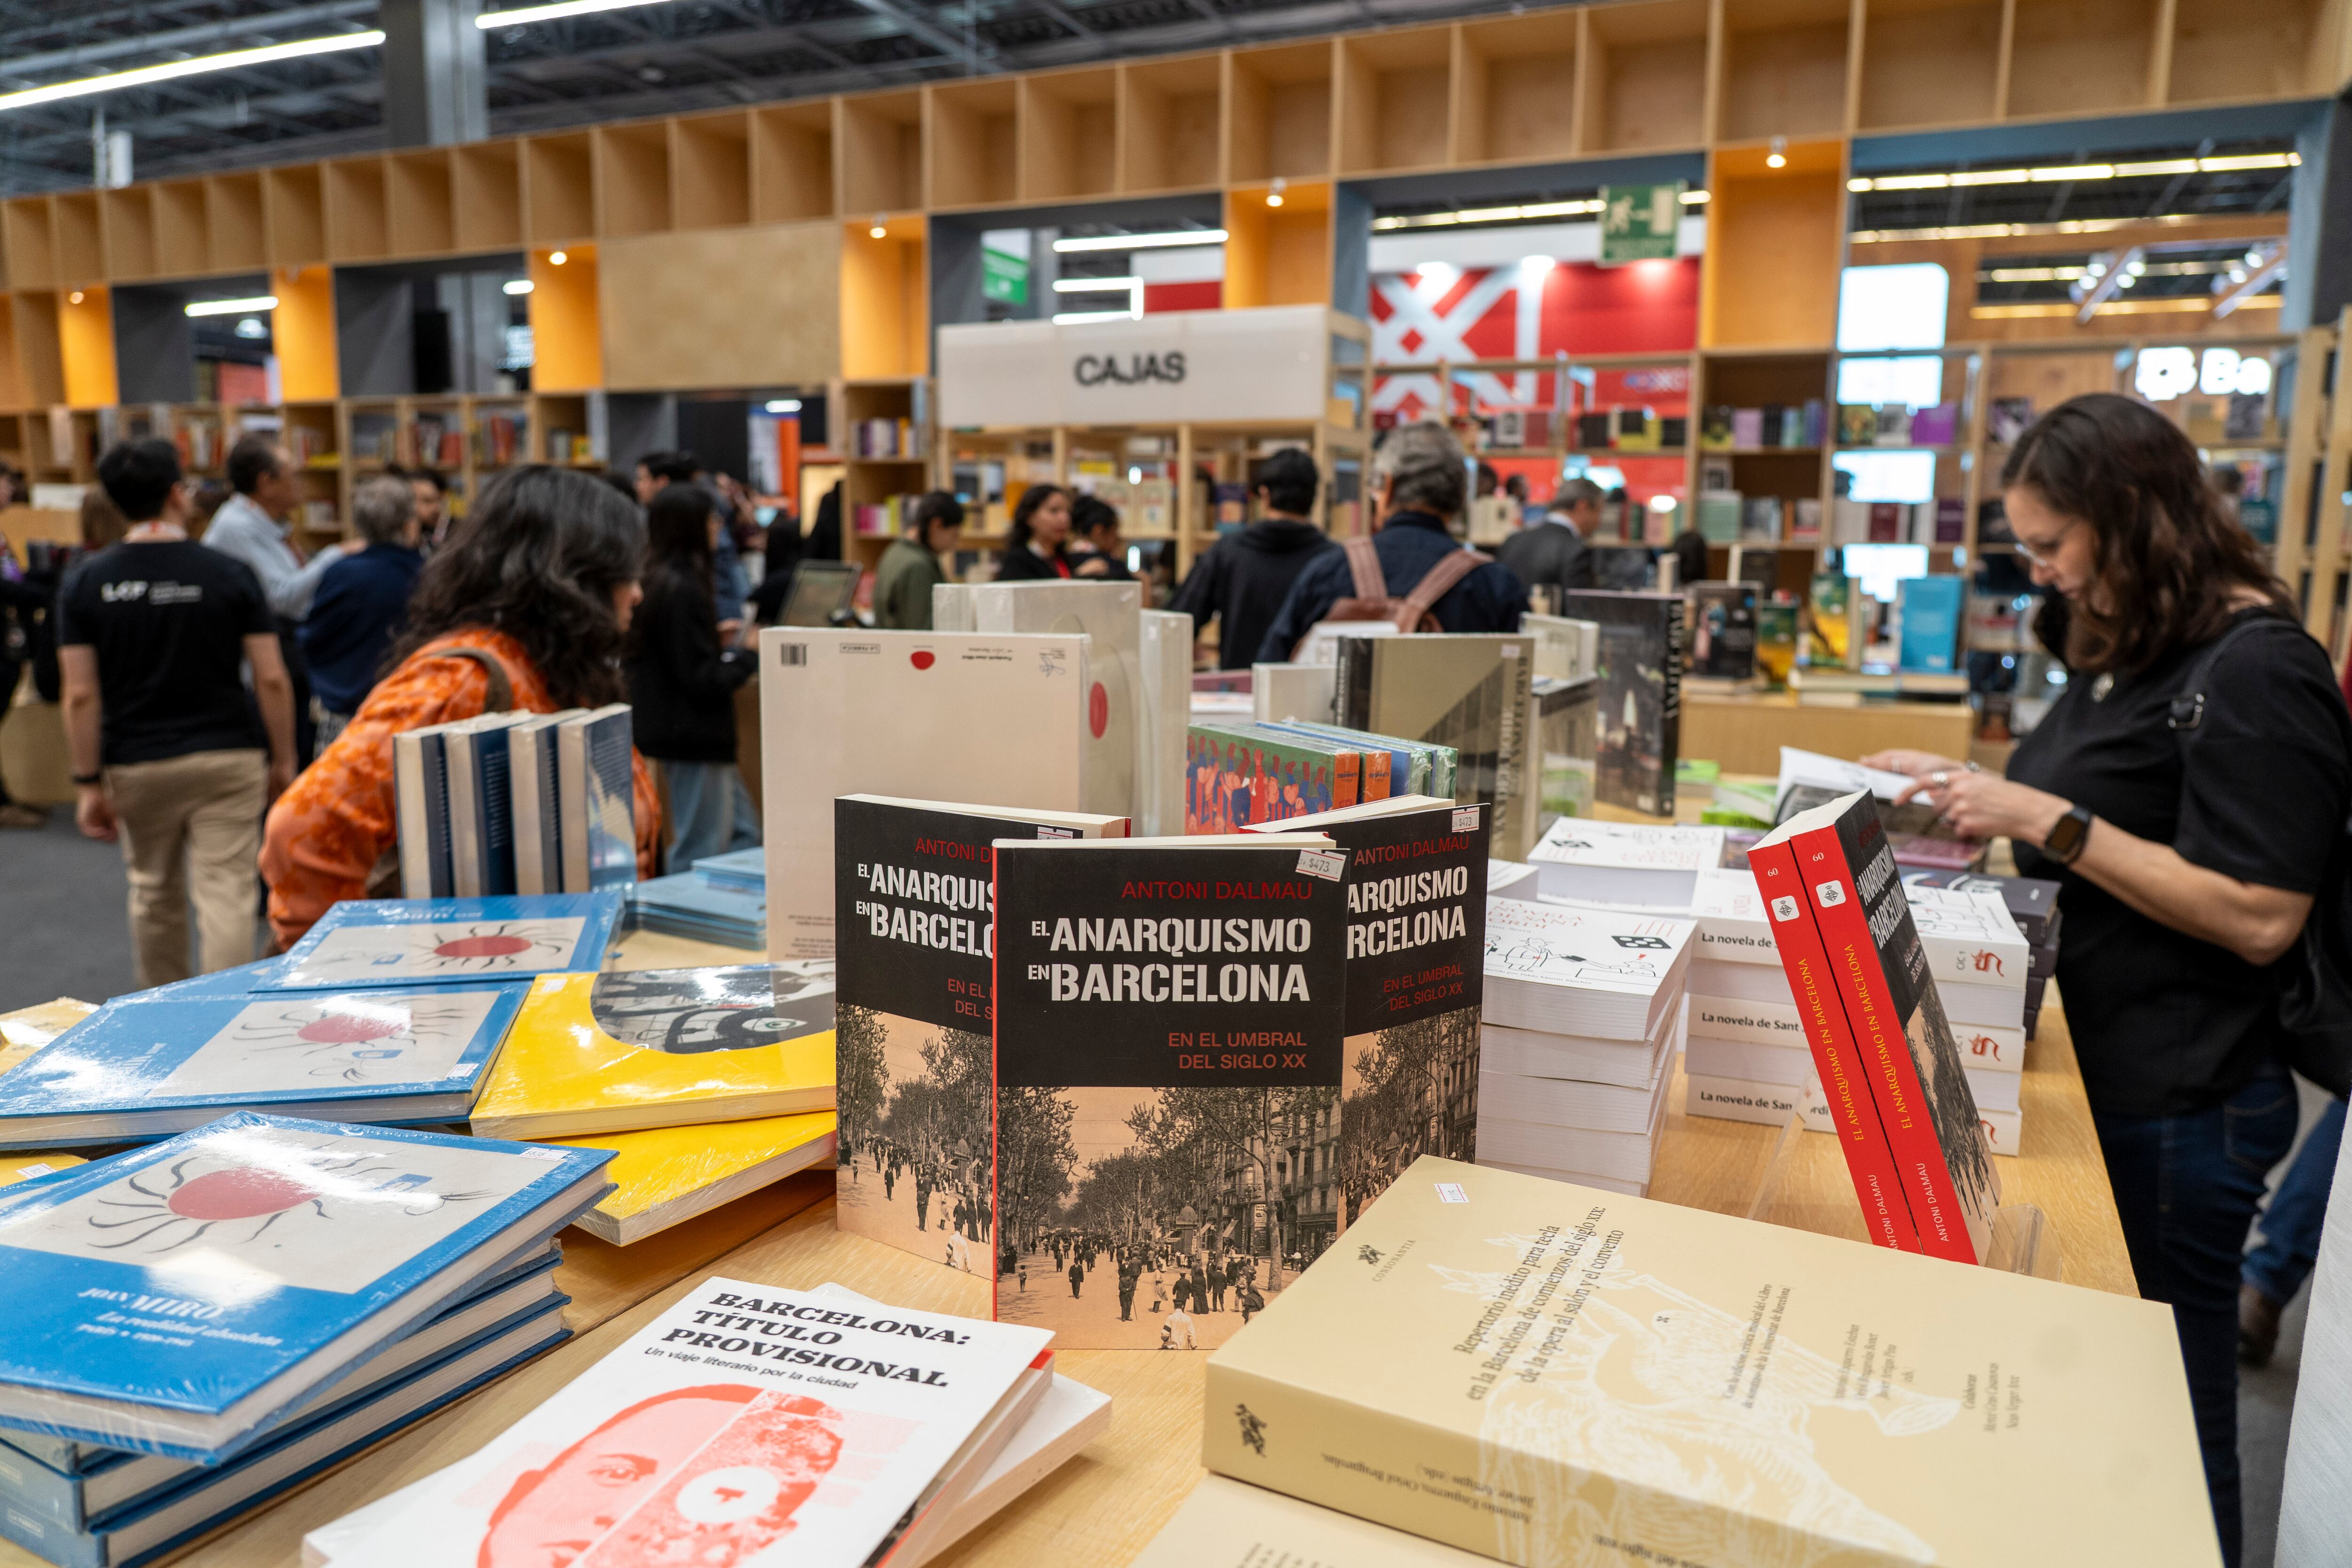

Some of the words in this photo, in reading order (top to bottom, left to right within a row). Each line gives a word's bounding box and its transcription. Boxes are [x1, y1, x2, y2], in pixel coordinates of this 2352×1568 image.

[1073, 351, 1185, 387] CAJAS
[1459, 818, 1472, 828] $473
[915, 837, 975, 861] ANTONI
[1354, 844, 1409, 866] ANTONI
[1413, 835, 1469, 857] DALMAU
[1812, 852, 1824, 862] 60
[1309, 857, 1330, 873] $473
[1767, 868, 1778, 877] 60
[1858, 844, 1895, 906] ANARQUISMO
[858, 863, 870, 878] EL
[870, 863, 993, 913] ANARQUIS
[1121, 882, 1207, 899] ANTONI
[1216, 882, 1312, 899] DALMAU
[1348, 866, 1468, 915] ARQUISMO
[1870, 880, 1908, 950] BARCELONA
[856, 901, 870, 915] EN
[871, 902, 993, 959] BARCEL
[1032, 921, 1050, 936] EL
[1050, 918, 1311, 957] ANARQUISMO
[1347, 906, 1466, 959] RCELONA
[1702, 932, 1714, 942] La
[1717, 936, 1755, 946] novela
[1757, 939, 1772, 947] de
[948, 979, 966, 993] EN
[969, 982, 985, 998] EL
[1028, 965, 1049, 979] EN
[1051, 963, 1310, 1002] BARCELONA
[1383, 979, 1399, 993] EN
[1403, 975, 1415, 989] EL
[1418, 963, 1463, 986] UMBRAL
[1798, 958, 1827, 1025] BARCELONA
[1844, 944, 1874, 1012] BARCELONA
[955, 1000, 980, 1017] DEL
[1390, 995, 1411, 1011] DEL
[1414, 985, 1446, 1005] SIGLO
[1448, 982, 1463, 996] XX
[1702, 1012, 1714, 1022] La
[1717, 1016, 1754, 1027] novela
[1757, 1019, 1770, 1028] de
[1774, 1020, 1798, 1031] Sant
[1820, 1029, 1833, 1043] EN
[1867, 1016, 1880, 1031] EN
[1168, 1033, 1193, 1046] EN
[1200, 1033, 1222, 1046] EL
[1228, 1033, 1307, 1047] UMBRAL
[1179, 1055, 1215, 1069] DEL
[1220, 1054, 1277, 1069] SIGLO
[1282, 1054, 1306, 1068] XX
[1874, 1035, 1907, 1114] ANARQUISMO
[1827, 1047, 1859, 1126] ANARQUISMO
[1701, 1091, 1713, 1100] La
[1716, 1095, 1752, 1106] novela
[1756, 1098, 1769, 1108] de
[1772, 1099, 1792, 1110] San
[1810, 1106, 1828, 1115] rdi
[1853, 1128, 1864, 1141] EL
[1902, 1116, 1912, 1129] EL
[1867, 1175, 1888, 1214] DALMAU
[1916, 1163, 1937, 1203] DALMAU
[1570, 1222, 1597, 1242] siglo
[1931, 1207, 1949, 1242] ANTONI
[1372, 1240, 1416, 1281] CONSONANTIA
[1559, 1242, 1583, 1257] del
[1590, 1230, 1624, 1269] convento
[1532, 1257, 1573, 1306] comienzos
[1580, 1279, 1600, 1289] y
[1581, 1269, 1601, 1280] el
[1453, 1300, 1507, 1354] Repertorio
[1493, 1267, 1531, 1302] inédito
[1523, 1245, 1545, 1269] para
[1536, 1226, 1560, 1247] tecla
[1563, 1288, 1590, 1314] salón
[709, 1293, 971, 1345] BARCELONA:
[1518, 1306, 1541, 1320] de
[1554, 1313, 1574, 1326] al
[691, 1312, 843, 1345] TÍTULO
[1532, 1326, 1567, 1356] ópera
[660, 1328, 949, 1387] PROVISIONAL
[1481, 1320, 1532, 1372] Barcelona
[644, 1347, 664, 1357] Un
[668, 1351, 700, 1364] viaje
[703, 1356, 757, 1372] literario
[759, 1366, 785, 1378] por
[788, 1370, 803, 1380] la
[806, 1373, 859, 1390] ciudad
[1523, 1355, 1548, 1368] la
[1471, 1371, 1496, 1385] la
[1515, 1370, 1541, 1384] de
[1467, 1385, 1487, 1401] en
